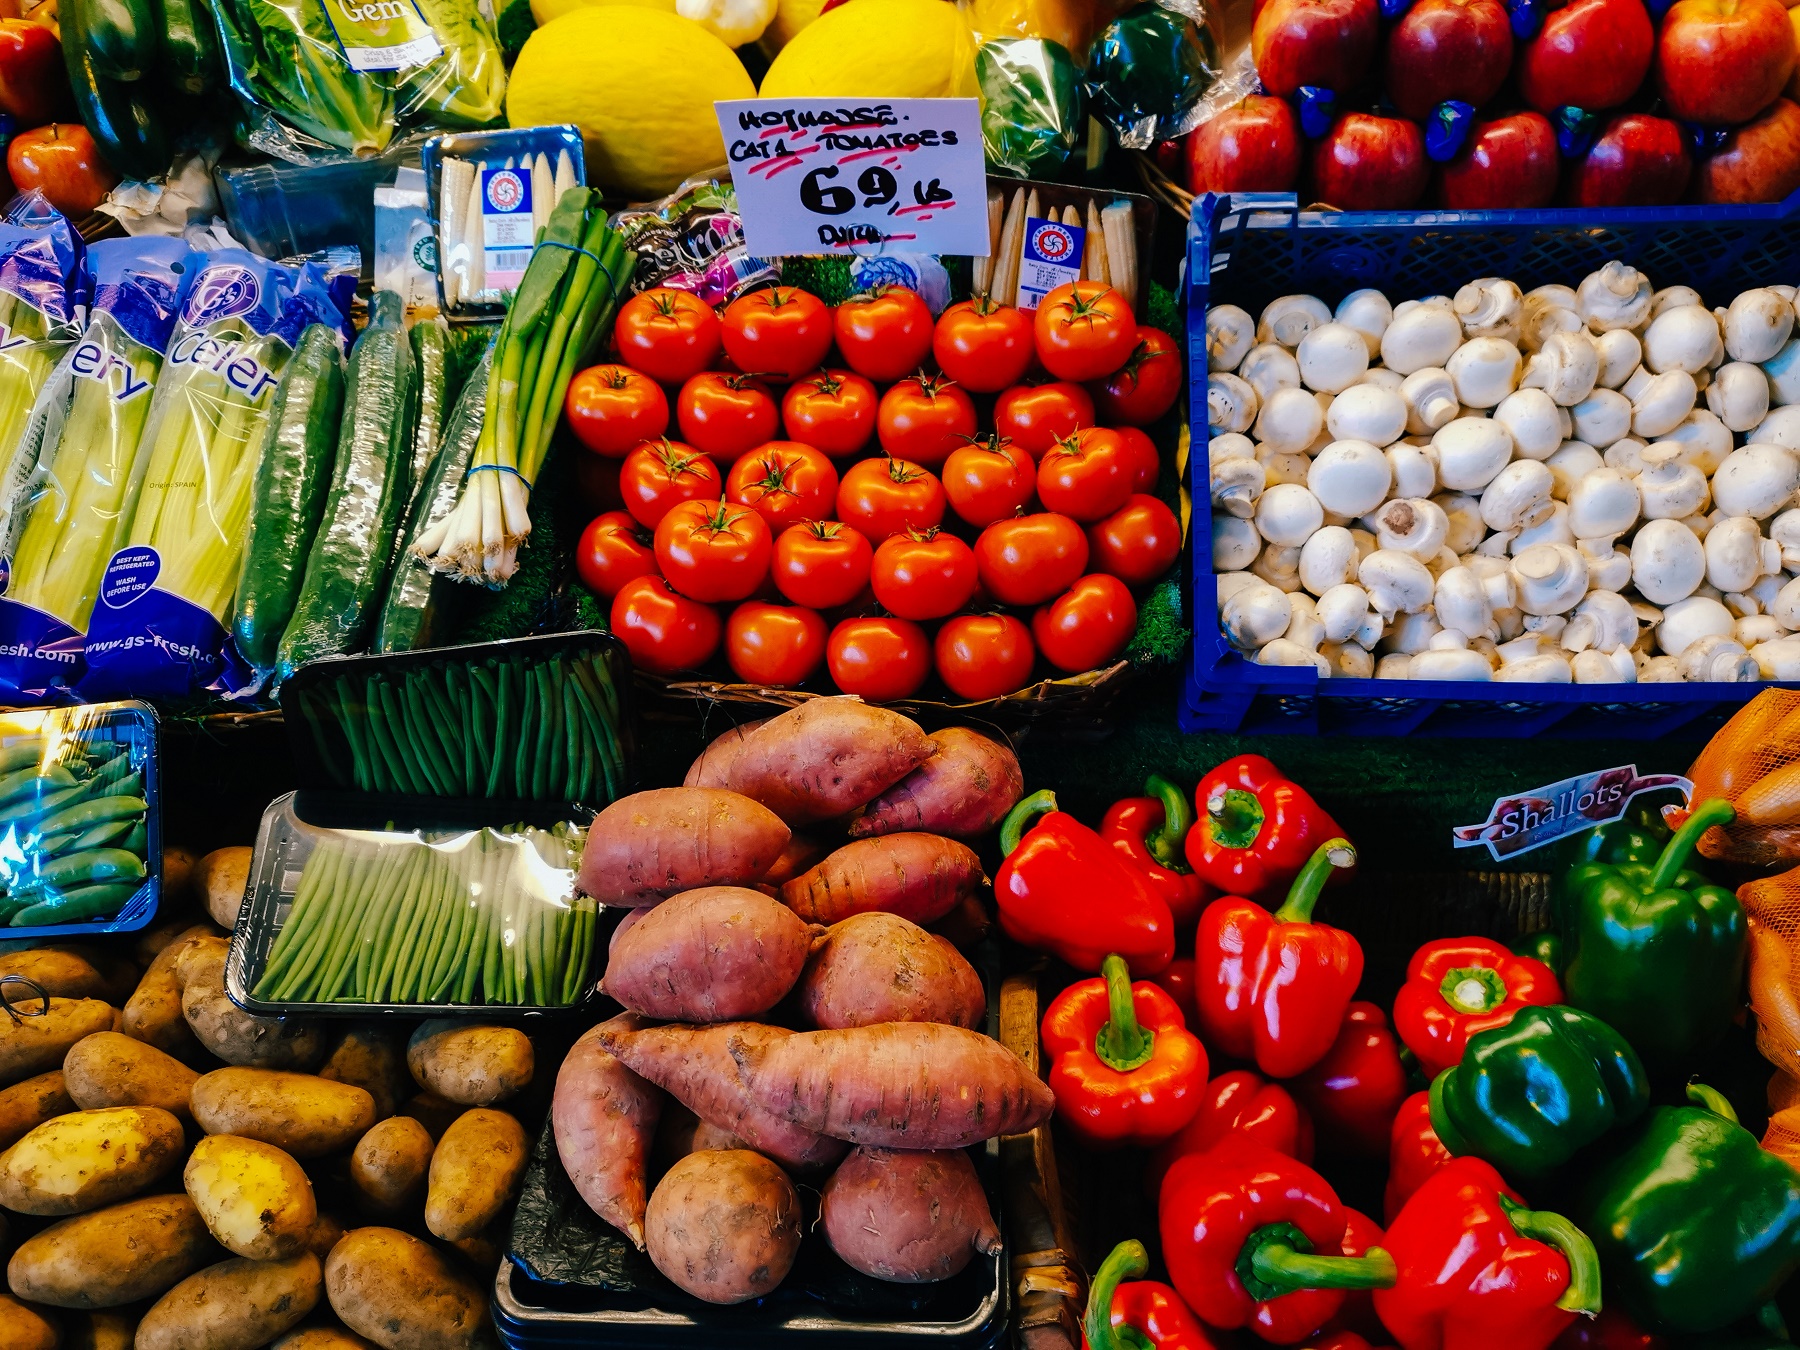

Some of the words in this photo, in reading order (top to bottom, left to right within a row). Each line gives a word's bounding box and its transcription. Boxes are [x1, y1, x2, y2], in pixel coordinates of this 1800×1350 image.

[338, 0, 411, 22] Gem
[815, 130, 958, 150] TOMATOES
[109, 561, 155, 573] REFRIGERATED
[116, 556, 132, 564] BEST
[116, 577, 136, 586] WASH
[106, 585, 131, 597] BEFORE
[131, 583, 147, 591] USE
[1501, 783, 1624, 838] Shallots
